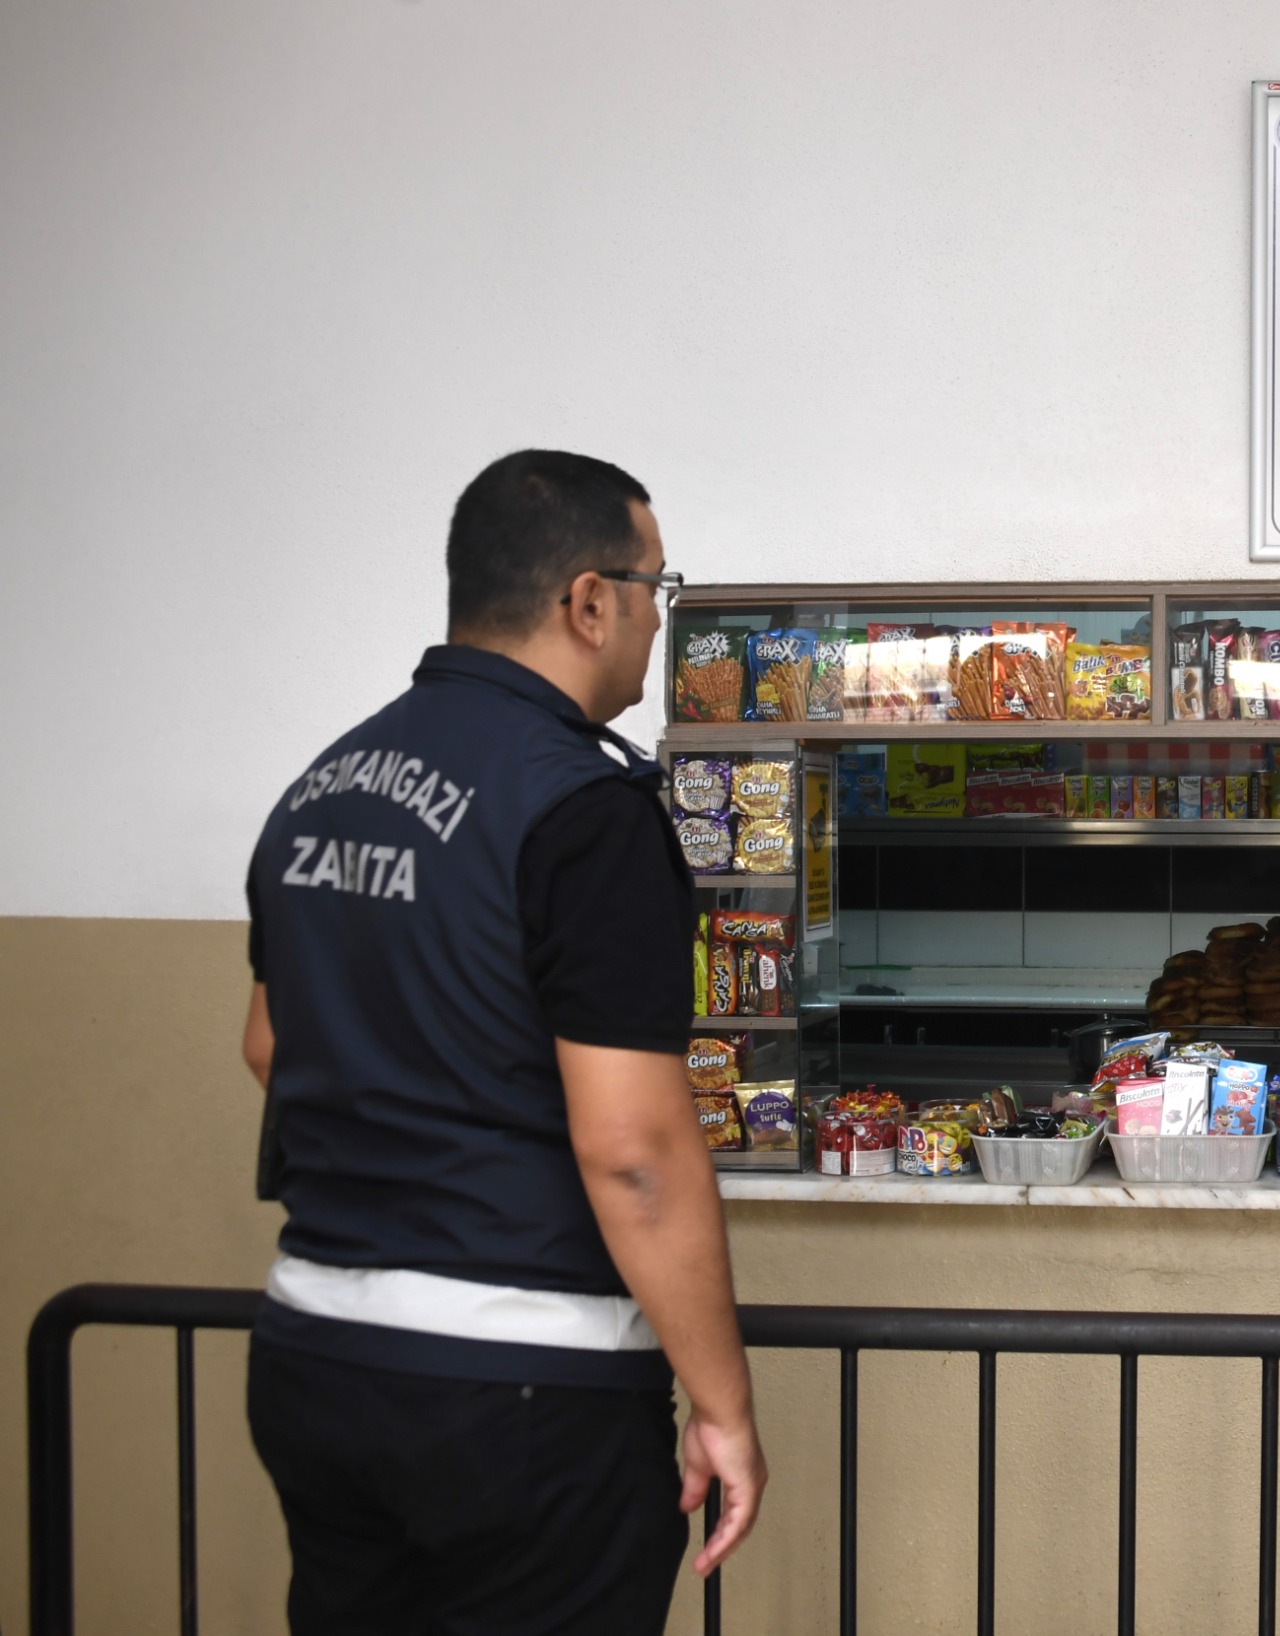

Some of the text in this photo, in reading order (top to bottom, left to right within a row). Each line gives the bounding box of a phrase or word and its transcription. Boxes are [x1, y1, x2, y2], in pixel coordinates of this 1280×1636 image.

[756, 637, 800, 666] CRAX
[815, 638, 847, 666] RAX
[1214, 642, 1226, 686] KOMBO
[674, 776, 714, 790] Gong
[740, 782, 780, 796] Gong
[680, 832, 720, 846] Gong
[744, 836, 784, 852] Gong
[721, 920, 769, 937] CANGA
[715, 965, 733, 1013] CANGA
[687, 1053, 729, 1069] Gong
[1169, 1070, 1205, 1080] Biscolata
[1119, 1087, 1161, 1104] Biscolata
[749, 1100, 790, 1113] LUPPO
[700, 1109, 728, 1125] ong
